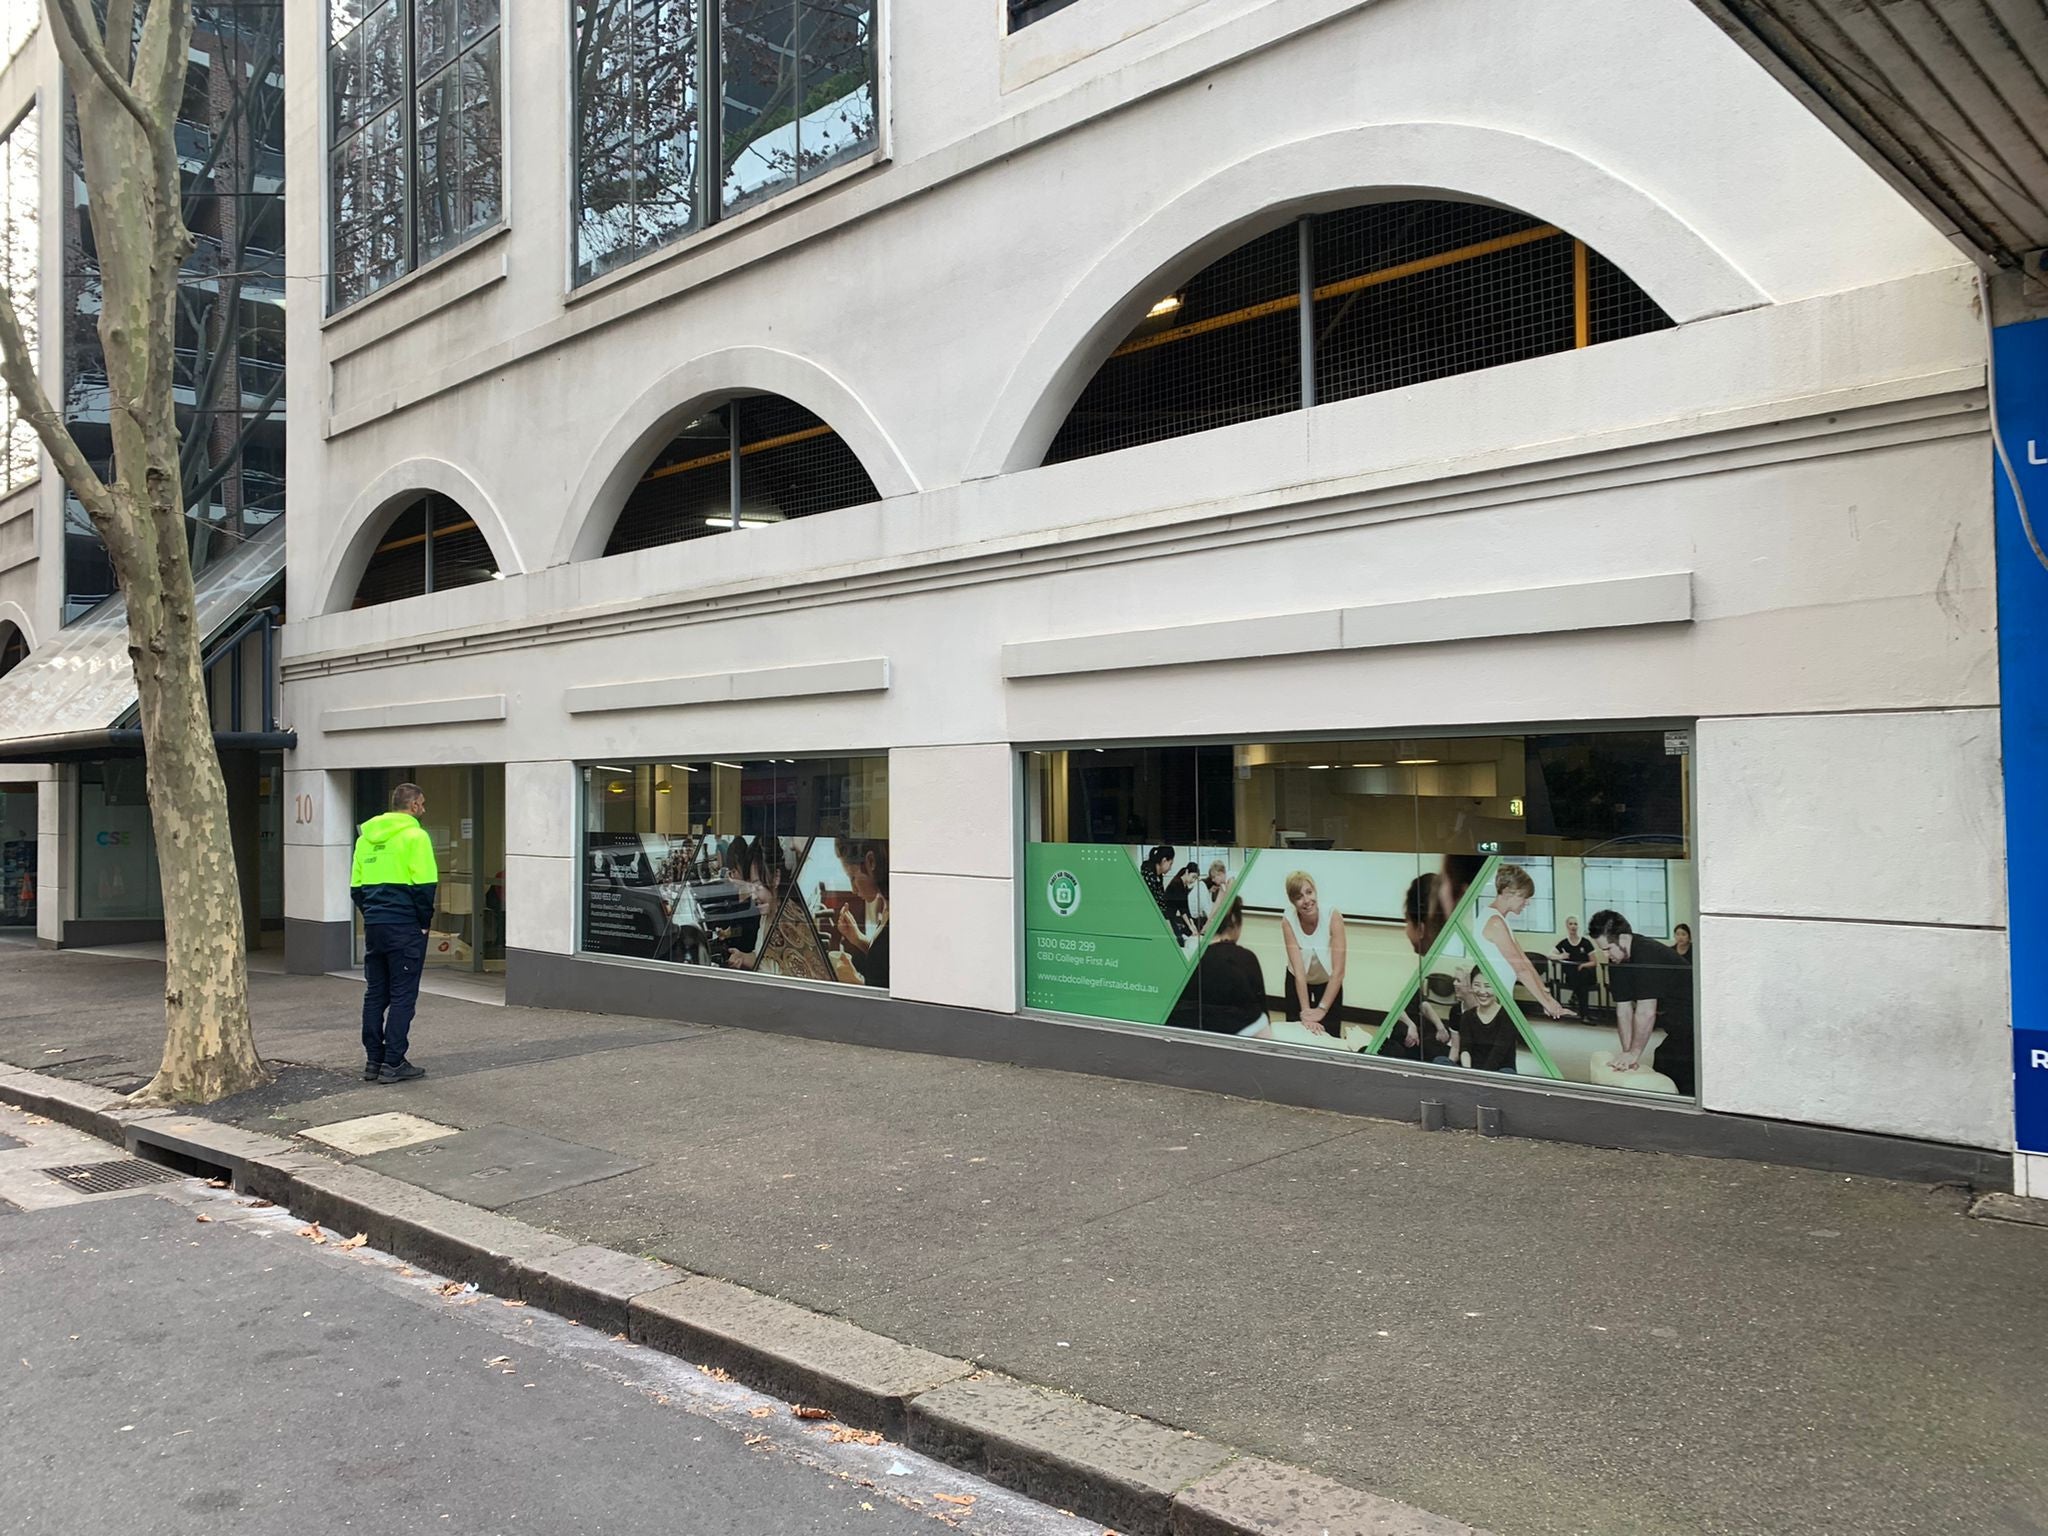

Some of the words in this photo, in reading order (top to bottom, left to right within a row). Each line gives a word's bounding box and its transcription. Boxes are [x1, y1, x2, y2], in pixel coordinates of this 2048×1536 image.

[295, 793, 313, 825] 10
[1037, 937, 1058, 949] 1300
[1060, 939, 1077, 951] 628
[1078, 941, 1096, 952] 299
[1037, 951, 1055, 961] CBD
[1055, 953, 1084, 966] College
[1085, 955, 1103, 967] First
[1104, 958, 1119, 968] Aid
[1038, 972, 1159, 994] www.cbdcollegefirstaid.edu.au
